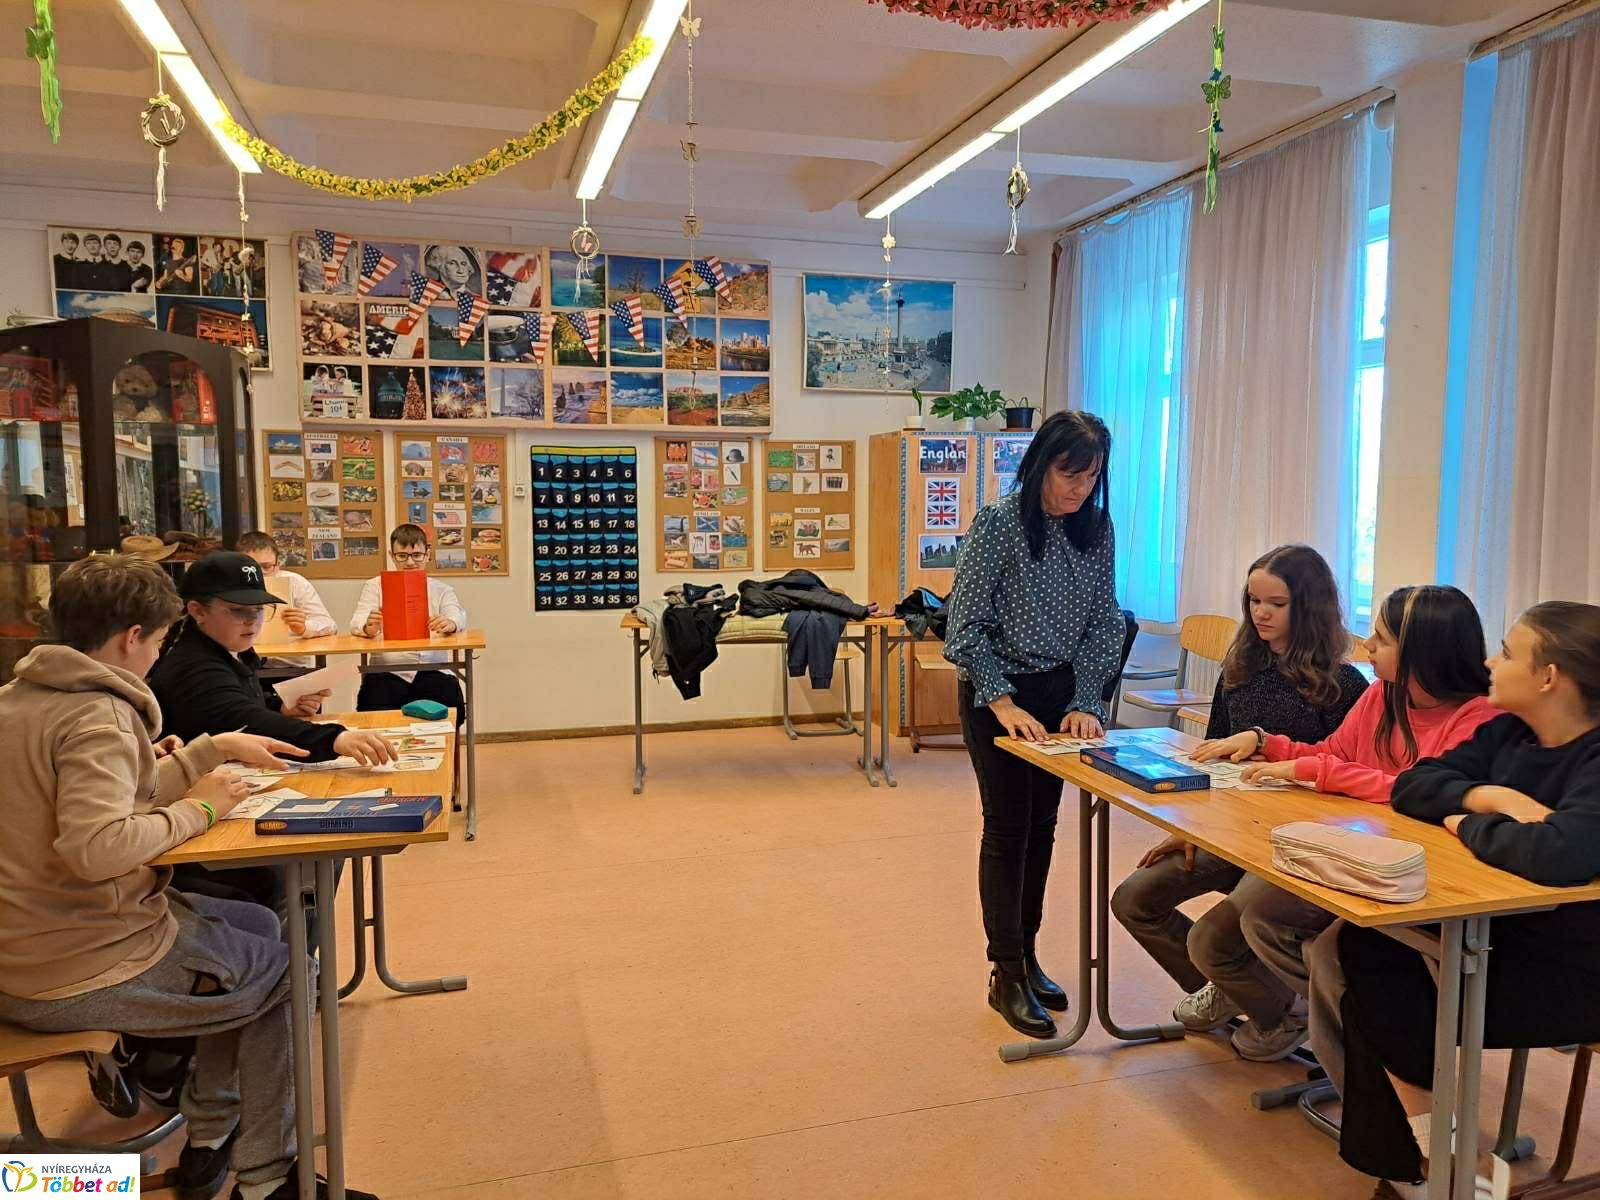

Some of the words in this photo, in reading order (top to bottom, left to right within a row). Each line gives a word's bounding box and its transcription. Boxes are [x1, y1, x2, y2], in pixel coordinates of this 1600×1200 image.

[369, 304, 408, 315] AMERIC
[920, 446, 966, 464] Englan
[539, 467, 544, 476] 1
[555, 469, 563, 478] 2
[573, 469, 580, 478] 3
[590, 469, 597, 478] 4
[607, 468, 614, 477] 5
[624, 469, 632, 478] 6
[540, 495, 546, 503] 7
[556, 494, 564, 504] 8
[574, 494, 581, 503] 9
[589, 493, 600, 502] 10
[606, 493, 616, 502] 11
[624, 495, 635, 503] 12
[537, 519, 548, 528] 13
[555, 521, 566, 529] 14
[572, 520, 584, 529] 15
[589, 520, 600, 529] 16
[608, 520, 618, 528] 17
[624, 520, 635, 528] 18
[537, 545, 549, 554] 19
[554, 546, 567, 555] 20
[572, 545, 584, 554] 21
[589, 545, 601, 554] 22
[606, 544, 618, 554] 23
[624, 546, 636, 554] 24
[540, 573, 551, 581] 25
[556, 572, 569, 581] 26
[574, 571, 586, 580] 27
[591, 571, 603, 580] 28
[607, 571, 619, 580] 29
[625, 571, 637, 579] 30
[540, 596, 551, 605] 31
[555, 596, 568, 606] 32
[574, 595, 586, 604] 33
[592, 596, 604, 604] 34
[608, 595, 621, 603] 35
[625, 595, 637, 603] 36
